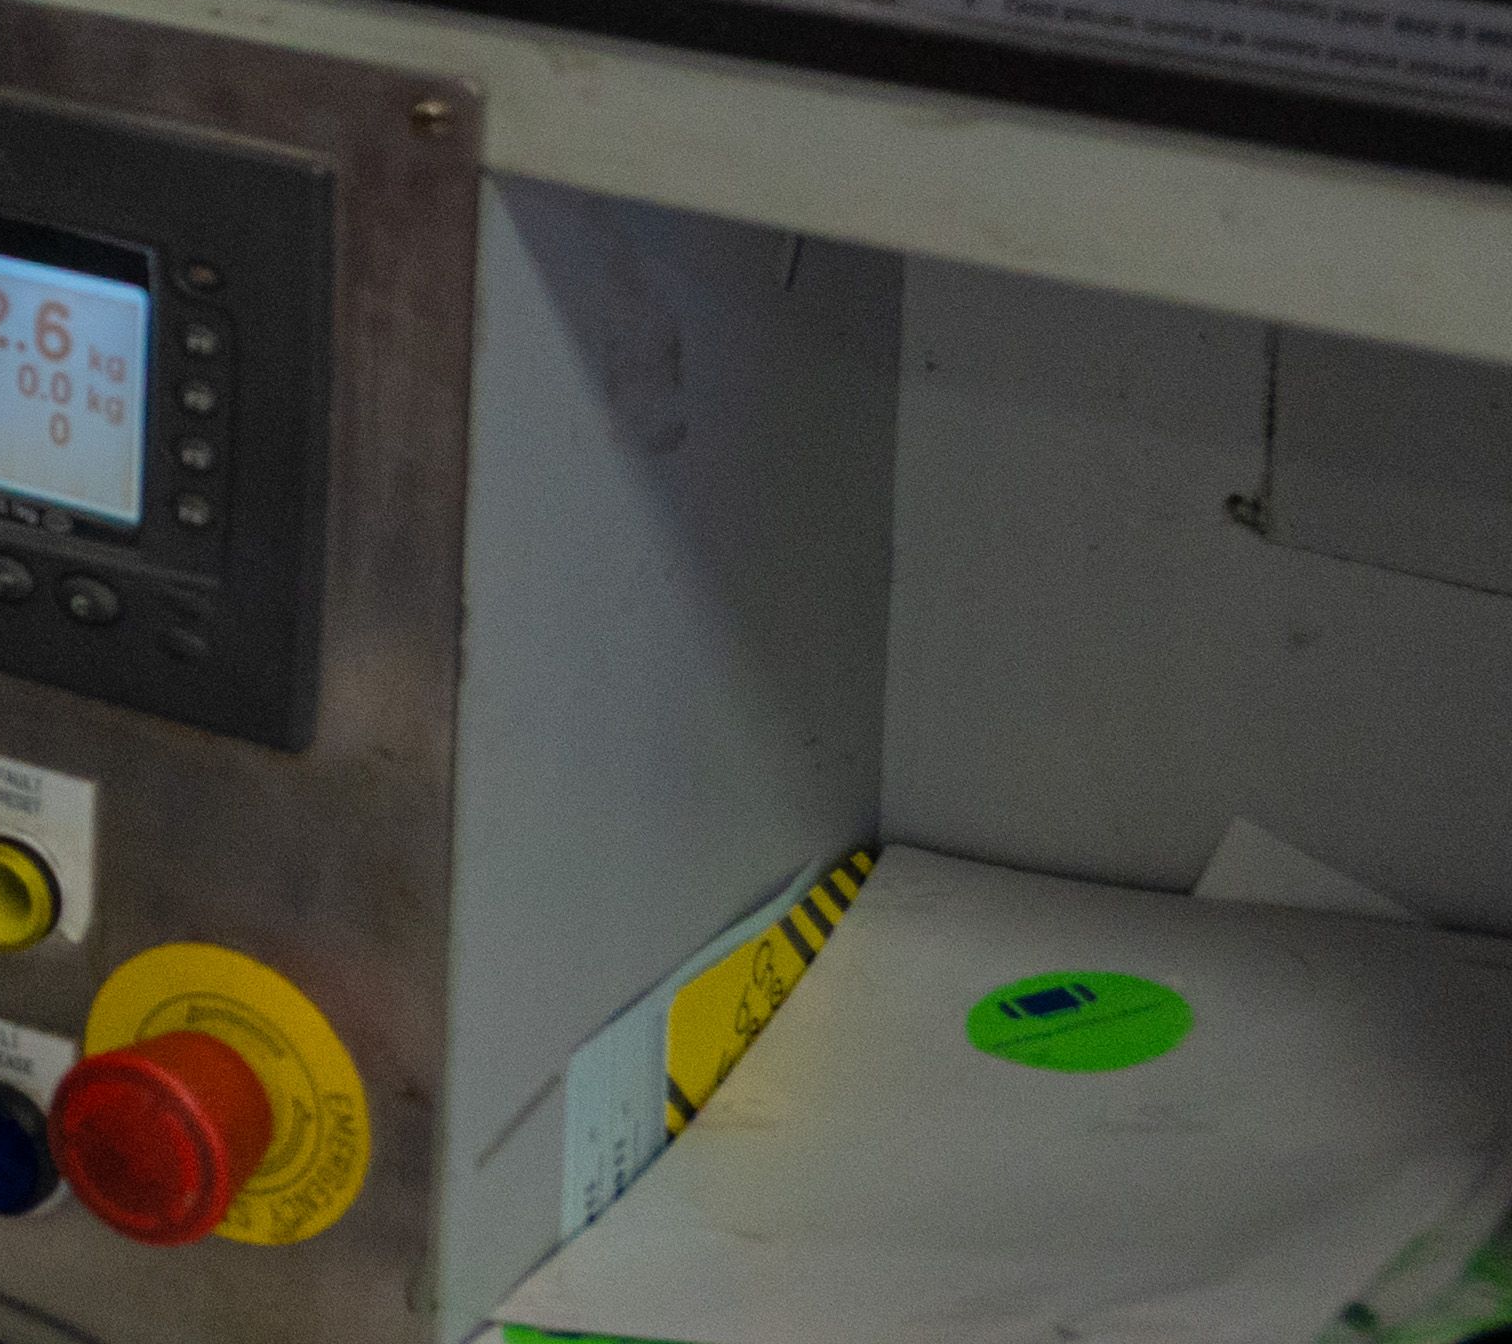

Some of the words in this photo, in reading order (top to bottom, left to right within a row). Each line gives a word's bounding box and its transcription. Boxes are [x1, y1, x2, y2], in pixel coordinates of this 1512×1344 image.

[87, 344, 129, 386] kg
[15, 359, 75, 408] 0.0
[86, 384, 128, 429] kg
[47, 410, 74, 450] 0
[268, 1091, 359, 1242] EMERGENCY
